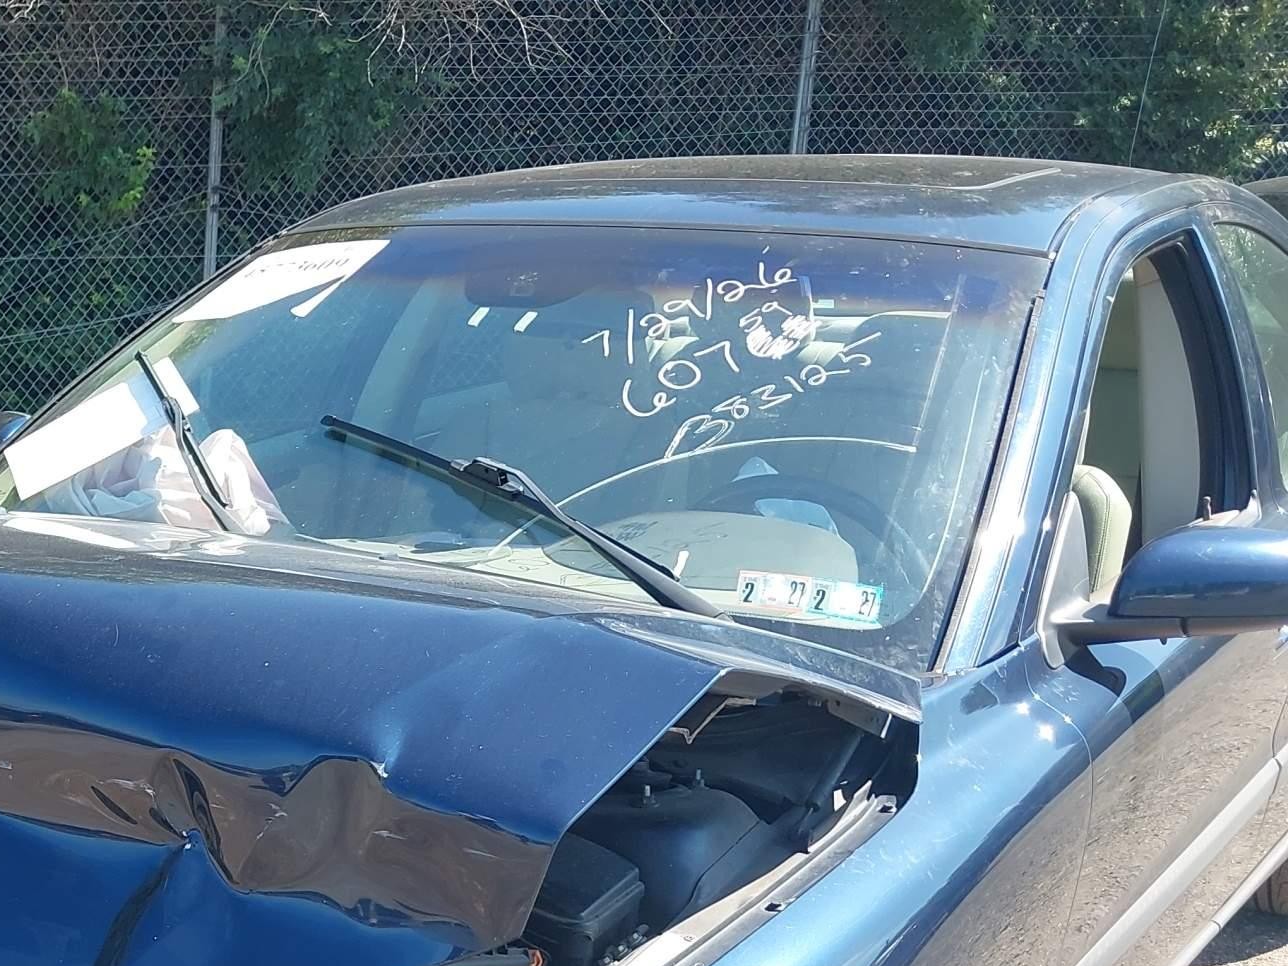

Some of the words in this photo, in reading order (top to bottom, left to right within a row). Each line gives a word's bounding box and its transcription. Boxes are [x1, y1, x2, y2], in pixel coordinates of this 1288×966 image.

[742, 582, 754, 603] 2
[788, 581, 806, 607] 27
[813, 589, 826, 611] 2
[858, 590, 877, 617] 27
